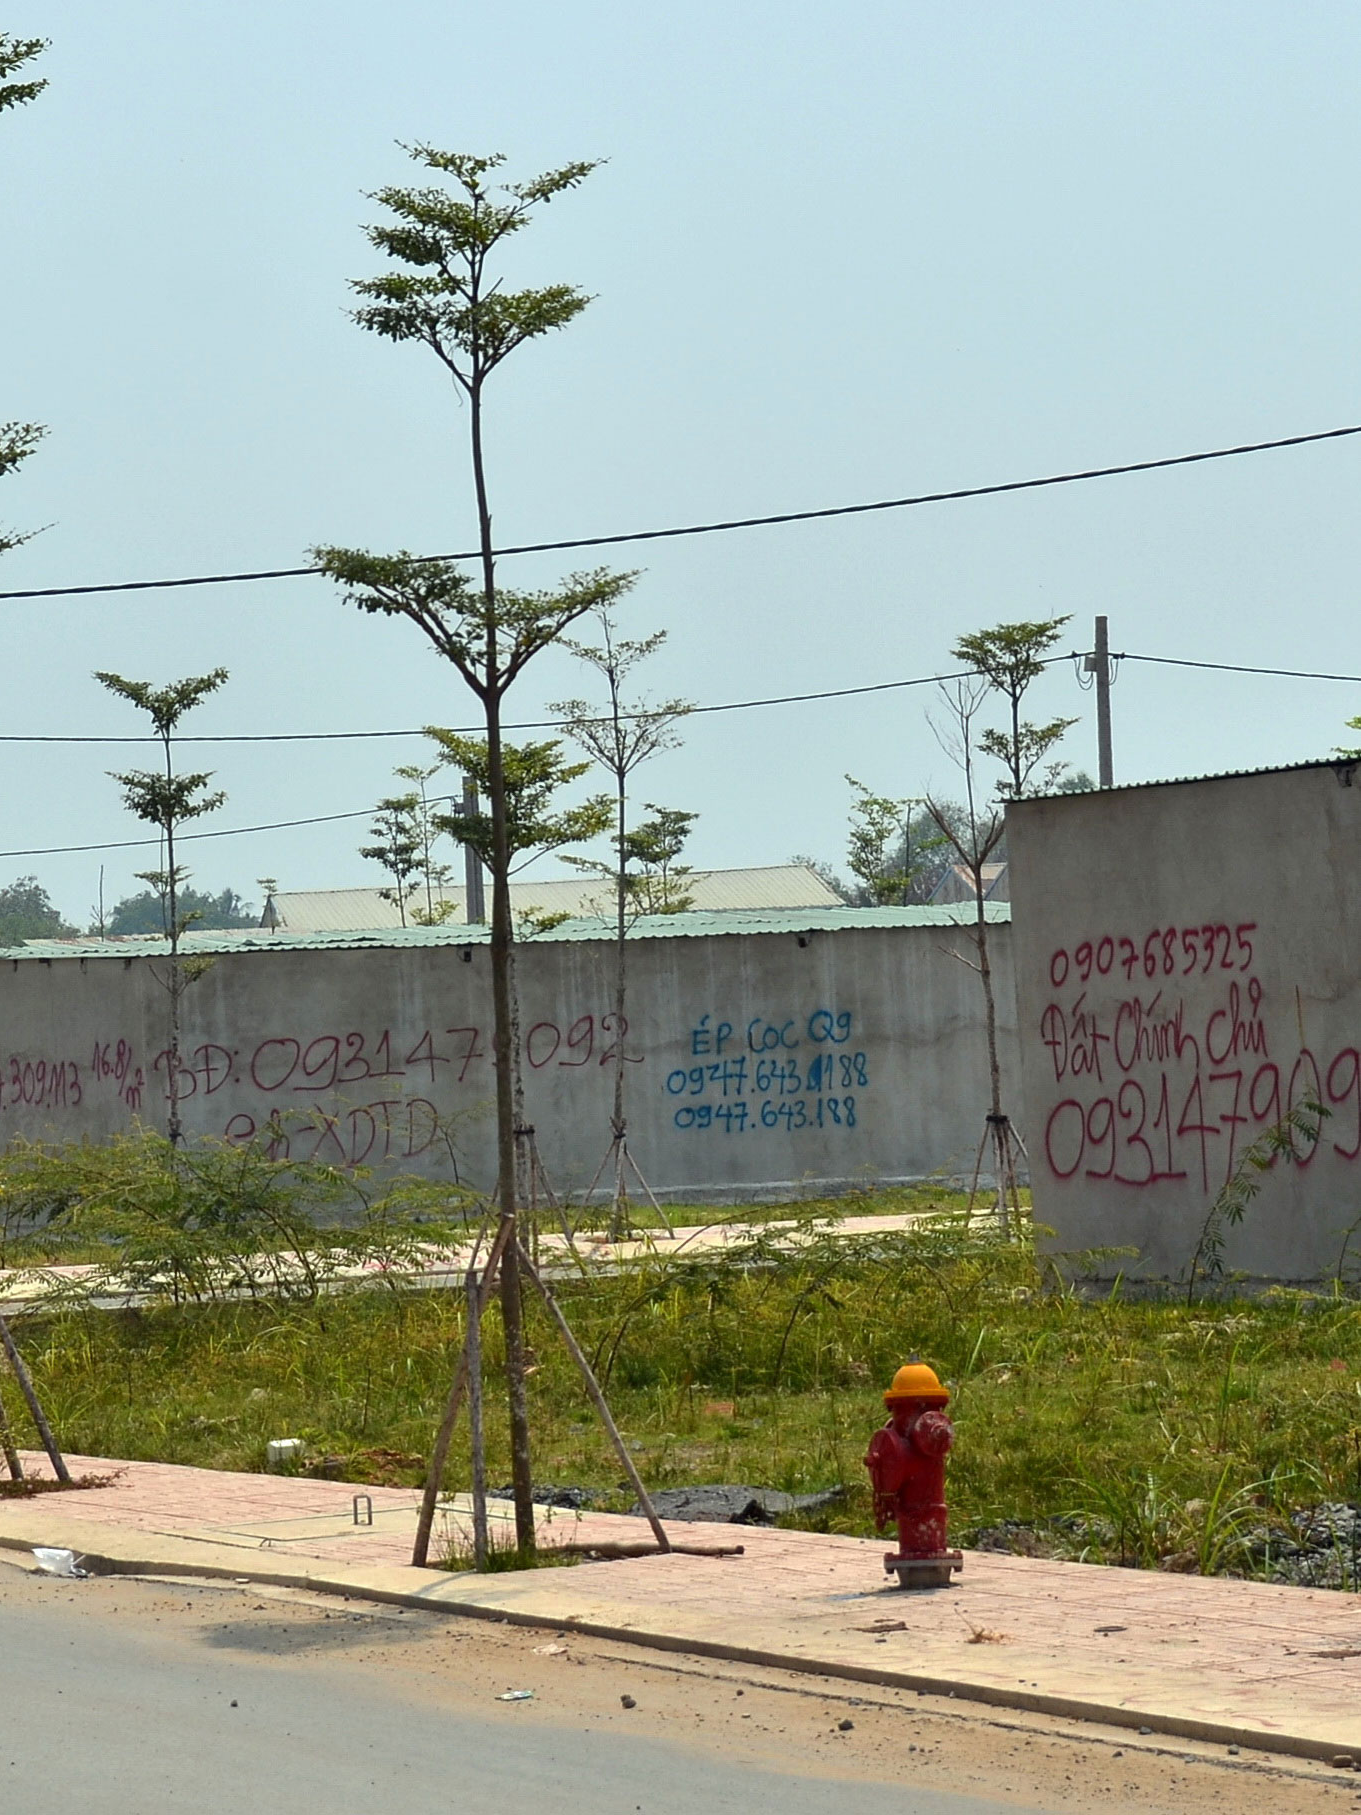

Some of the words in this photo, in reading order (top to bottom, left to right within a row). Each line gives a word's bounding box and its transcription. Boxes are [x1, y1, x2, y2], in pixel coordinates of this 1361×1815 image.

[1050, 922, 1258, 987] 0907685325
[251, 1013, 645, 1092] 093147092
[692, 1014, 733, 1055] ÉP
[808, 1009, 852, 1043] Q9
[1040, 991, 1111, 1083] Đất
[674, 1096, 857, 1132] 0947.643.188
